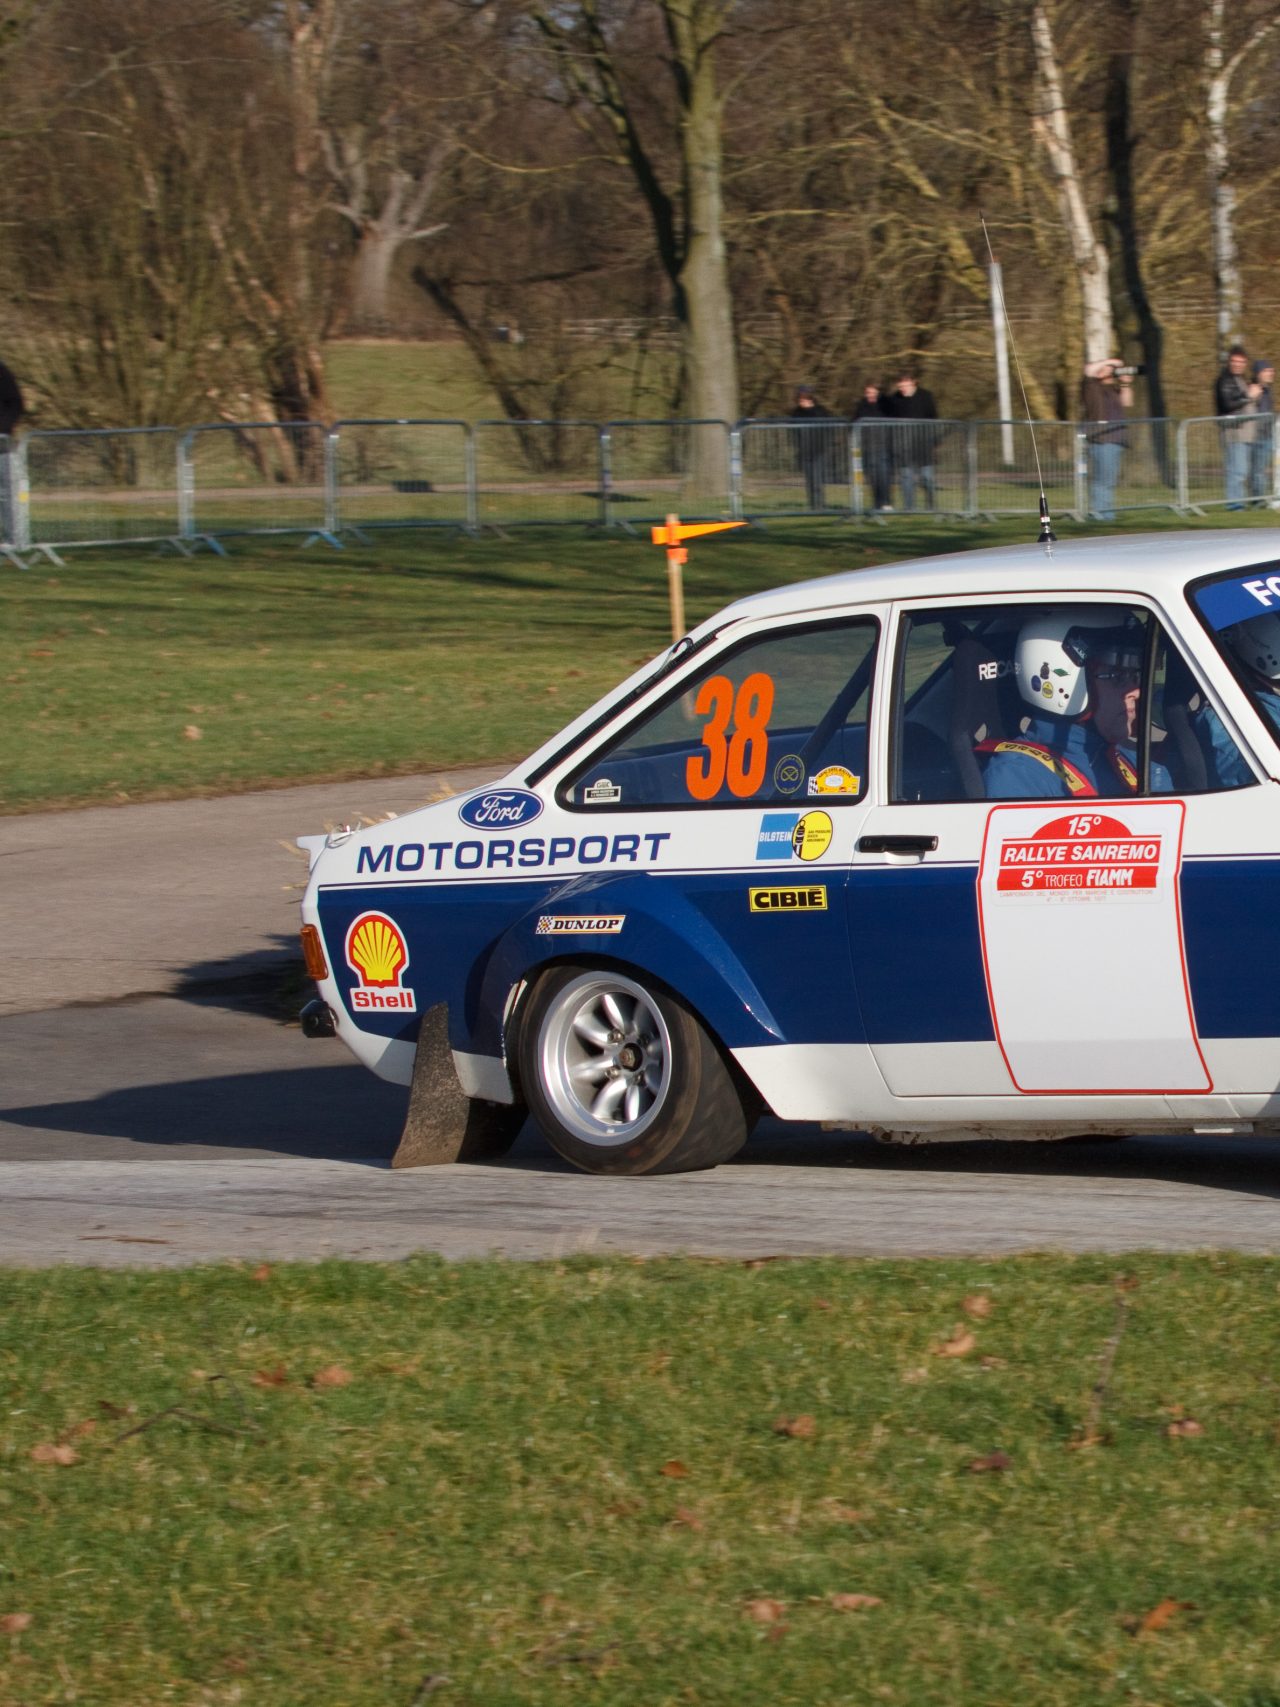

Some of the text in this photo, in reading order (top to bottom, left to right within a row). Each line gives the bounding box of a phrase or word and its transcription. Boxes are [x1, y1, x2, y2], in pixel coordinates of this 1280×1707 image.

[685, 671, 775, 800] 38
[475, 795, 525, 823] Ford
[760, 831, 793, 842] BILSTEIN
[356, 832, 671, 873] MOTORSPORT
[1003, 844, 1157, 862] RALLYE SANREMO
[1044, 874, 1083, 887] TROFEO
[1086, 869, 1134, 886] FIAMM
[552, 919, 620, 930] DUNLOP
[354, 991, 413, 1009] Shell
